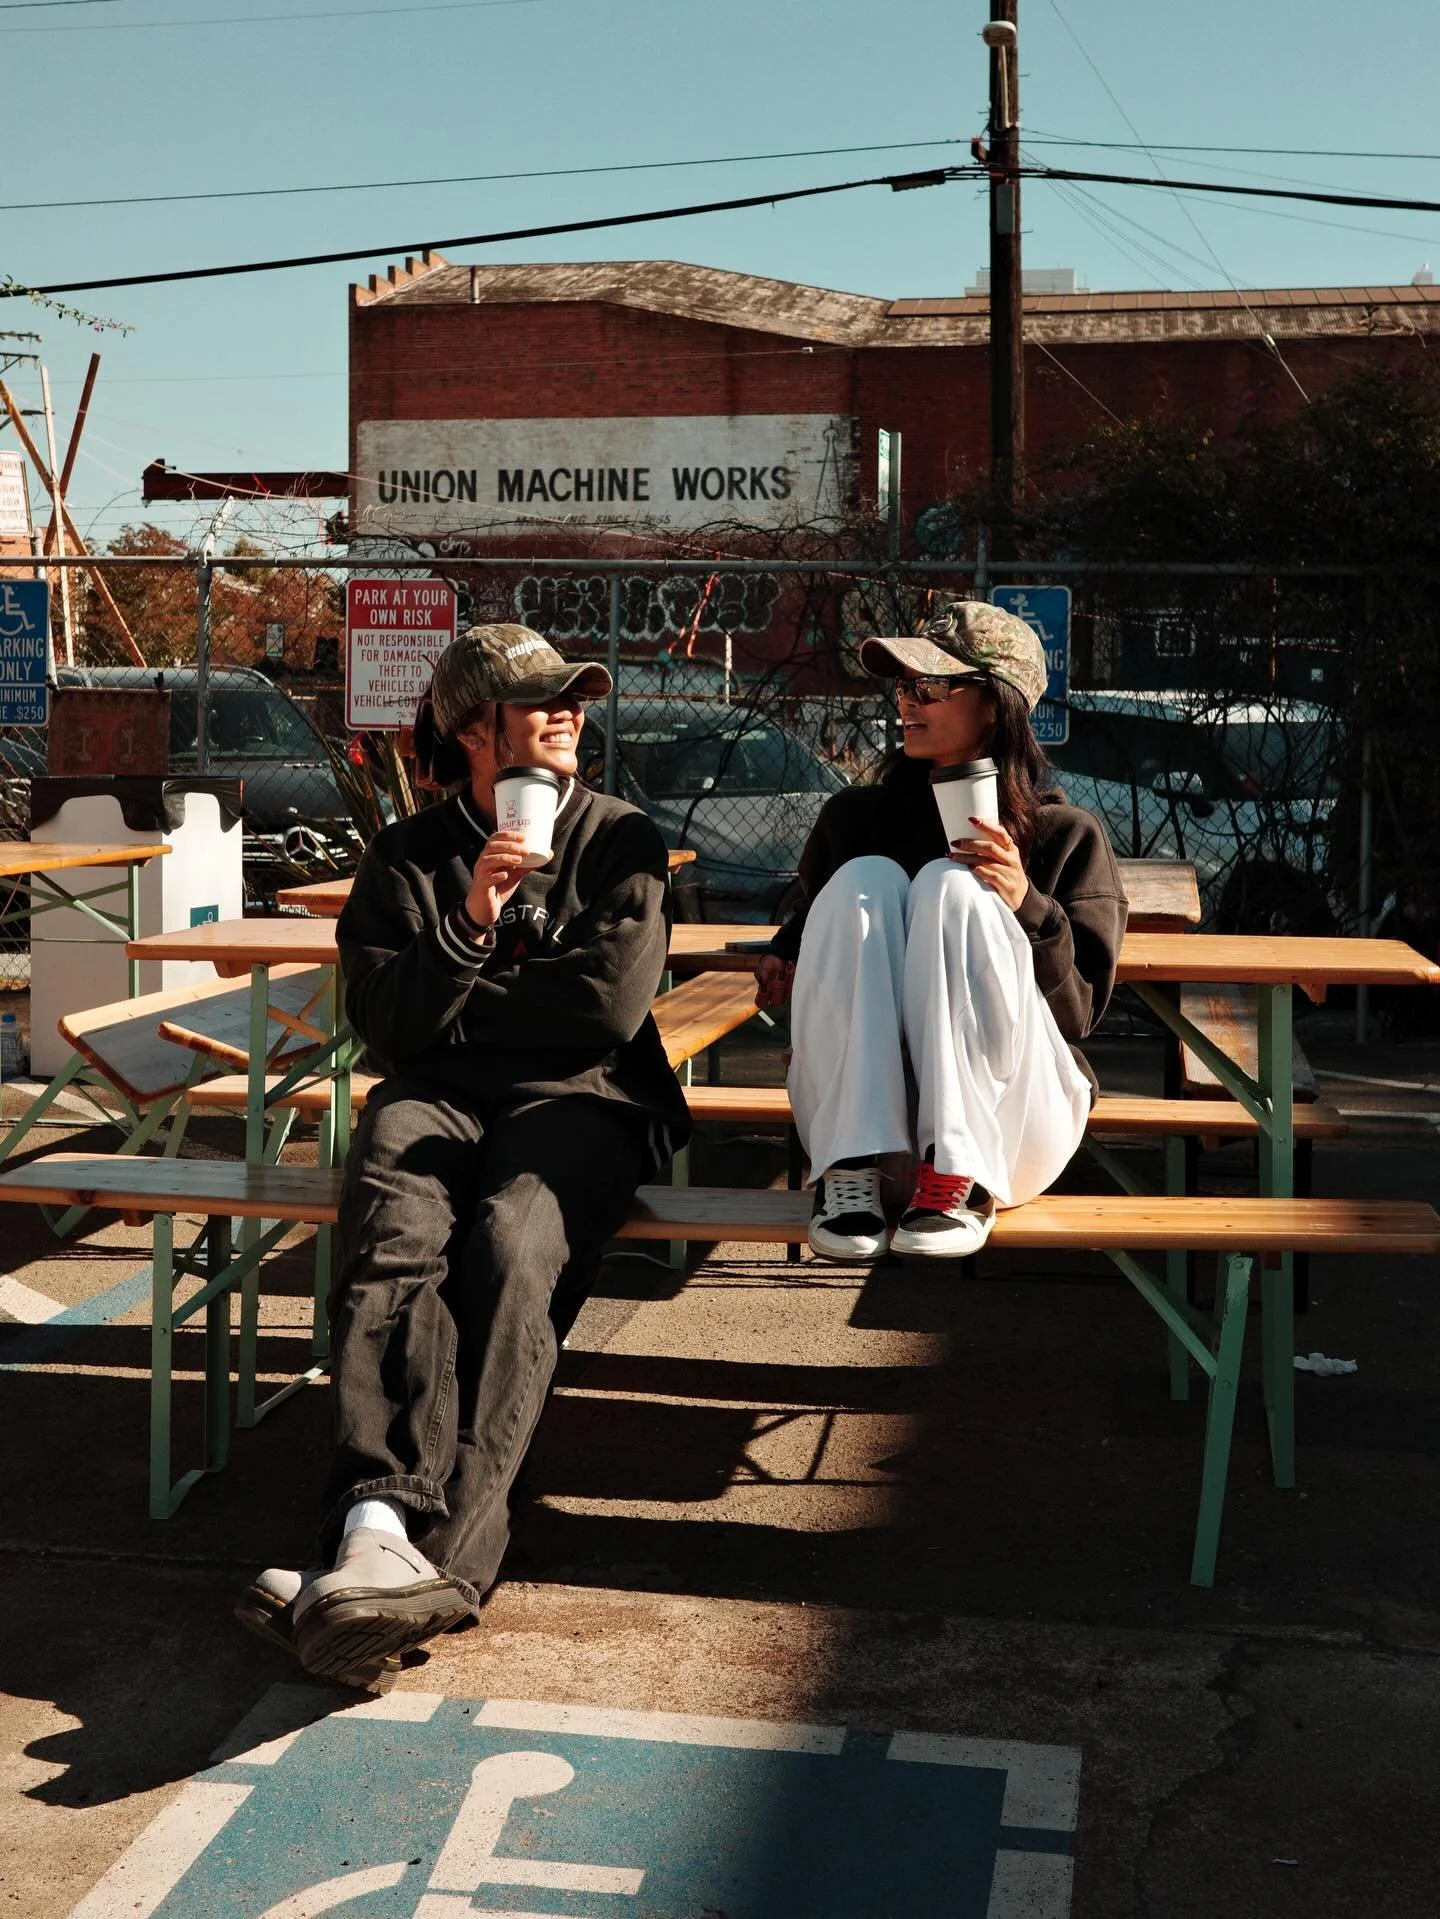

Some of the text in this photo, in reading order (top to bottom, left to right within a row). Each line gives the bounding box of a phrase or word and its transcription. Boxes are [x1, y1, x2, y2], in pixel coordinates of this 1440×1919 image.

[378, 465, 792, 503] UNION MACHINE WORKS
[355, 589, 448, 606] PARK AT YOUR
[370, 609, 432, 626] OWN RISK
[0, 637, 44, 659] RKING
[357, 634, 444, 648] NOT RESPONSIBLE
[361, 649, 439, 663] FOR DAMAGE OR
[379, 665, 422, 677] THEFT TO
[369, 680, 414, 693] VEHICLES
[0, 689, 36, 702] INIMUM
[354, 695, 393, 708] VEHICLE
[16, 706, 44, 720] $250
[517, 817, 532, 829] up
